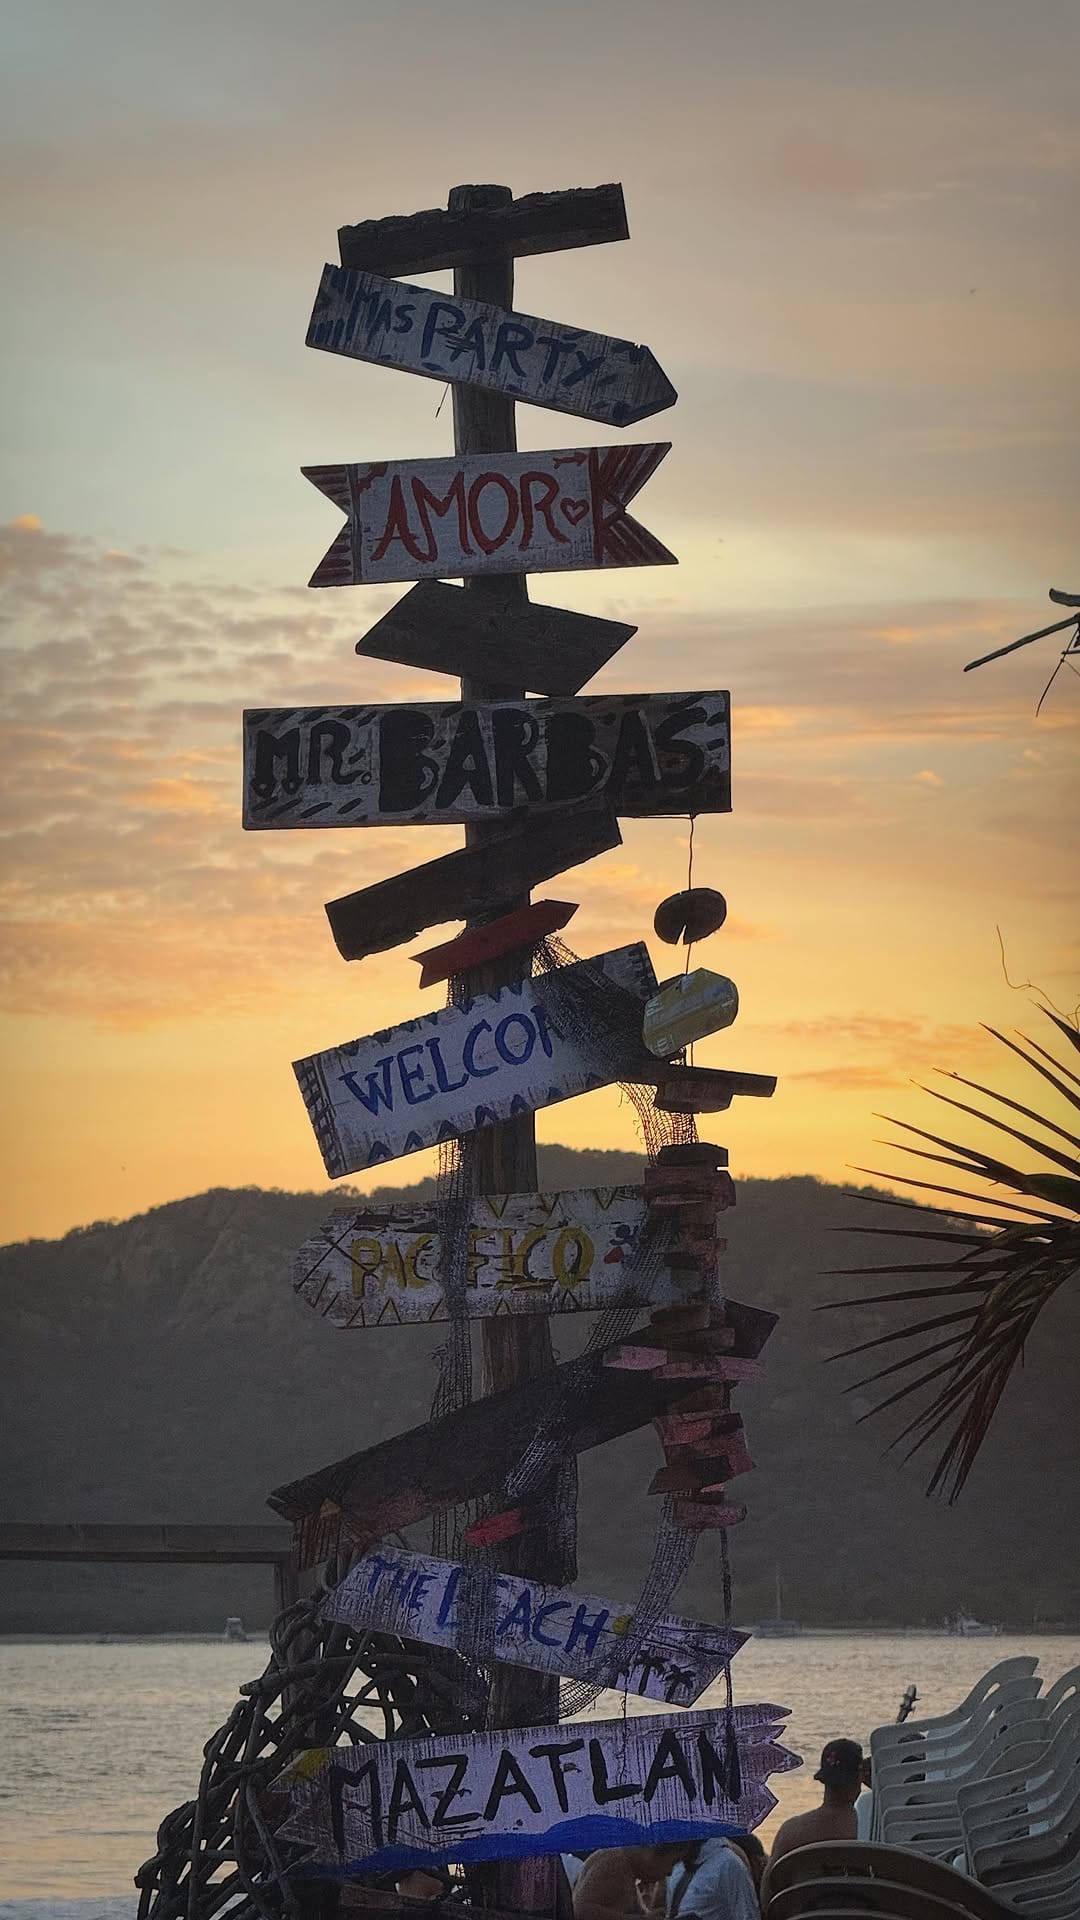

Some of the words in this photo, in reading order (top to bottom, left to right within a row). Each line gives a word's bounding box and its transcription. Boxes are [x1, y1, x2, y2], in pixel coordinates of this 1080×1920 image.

[420, 302, 606, 386] PARTY
[370, 470, 570, 562] AMOR
[250, 719, 372, 799] MR.
[379, 706, 708, 813] BARBAS
[339, 1005, 568, 1116] WELCO
[350, 1226, 595, 1299] PACFICO
[366, 1555, 438, 1609] THE
[437, 1567, 610, 1654] ACH
[328, 1728, 742, 1856] MAZATLAN
